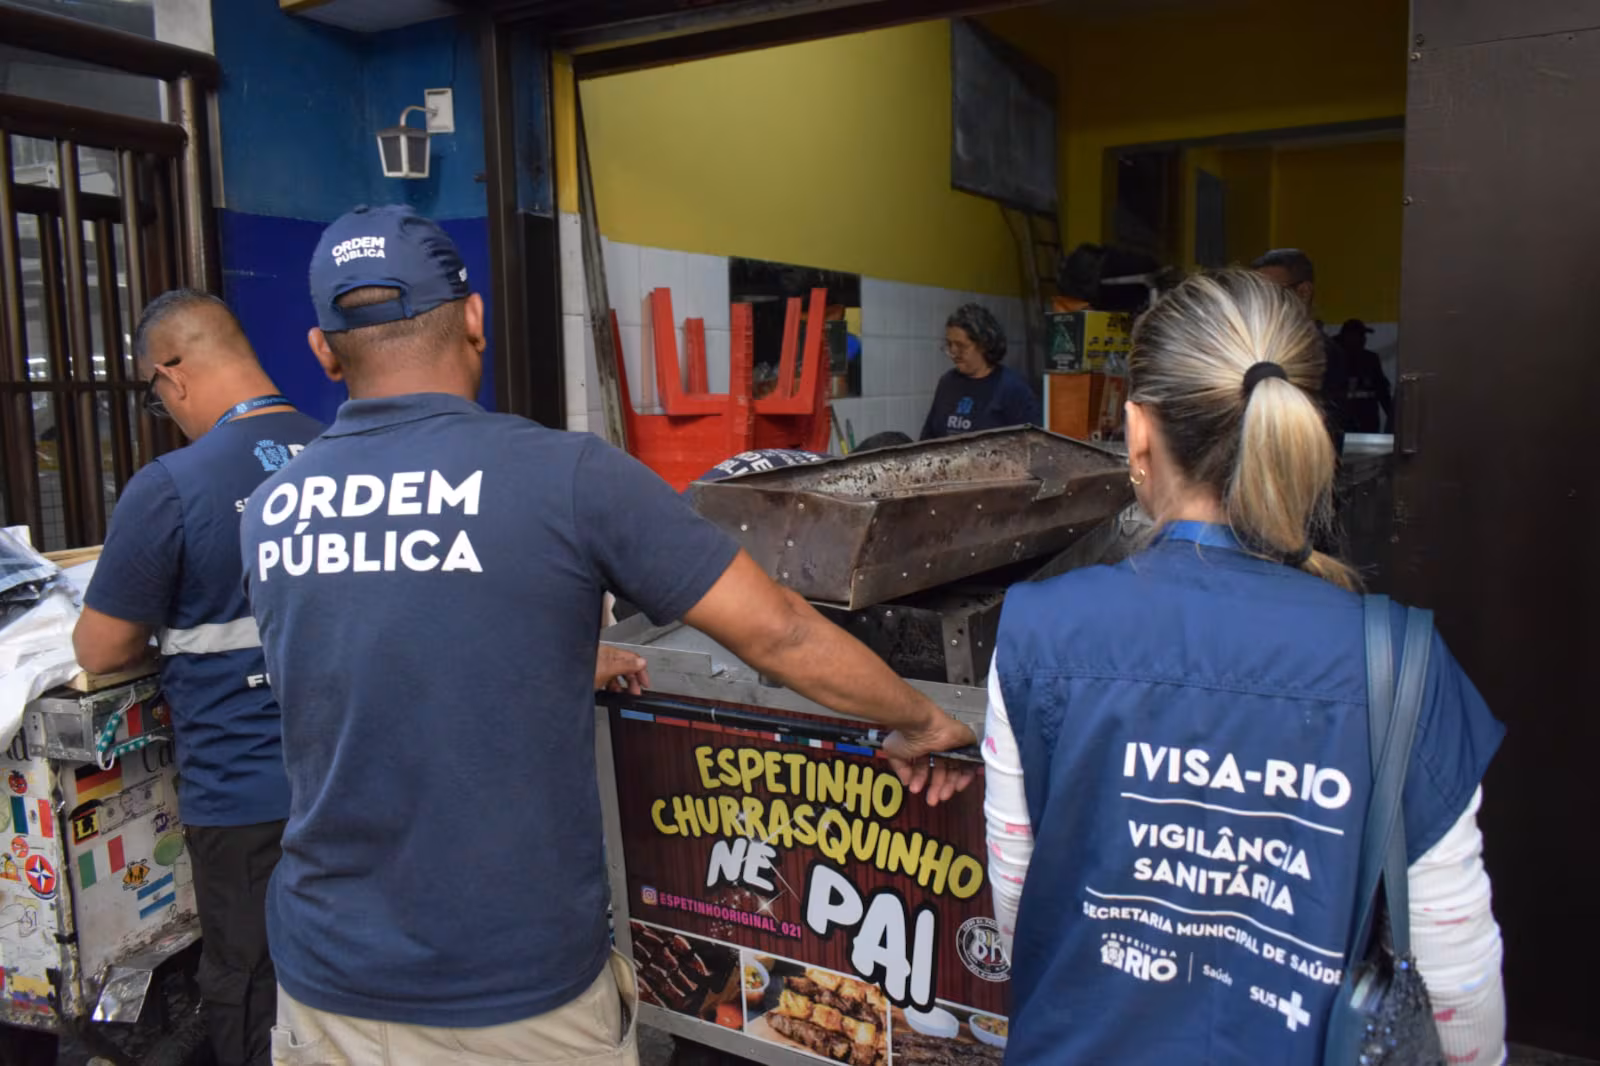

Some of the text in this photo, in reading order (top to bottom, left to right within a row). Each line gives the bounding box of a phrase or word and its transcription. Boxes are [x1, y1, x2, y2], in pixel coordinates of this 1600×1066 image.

[332, 236, 385, 257] ORDEM
[947, 415, 972, 430] Rio
[262, 469, 483, 526] ORDEM
[258, 521, 484, 582] PÚBLICA
[695, 746, 903, 818] ESPETINHO
[1122, 742, 1352, 809] IVISA-RIO
[651, 794, 983, 898] CHURRASQUINHO
[1128, 819, 1311, 881] VIGILÂNCIA
[659, 892, 801, 938] ESPETINHOORIGINAL_021
[1133, 857, 1294, 916] SANITÁRIA
[806, 864, 935, 1006] PAI
[1083, 900, 1342, 986] SECRETARIA MUNICIPAL DE SAÚDE
[1124, 946, 1178, 982] RIO
[1249, 985, 1278, 1009] SUS
